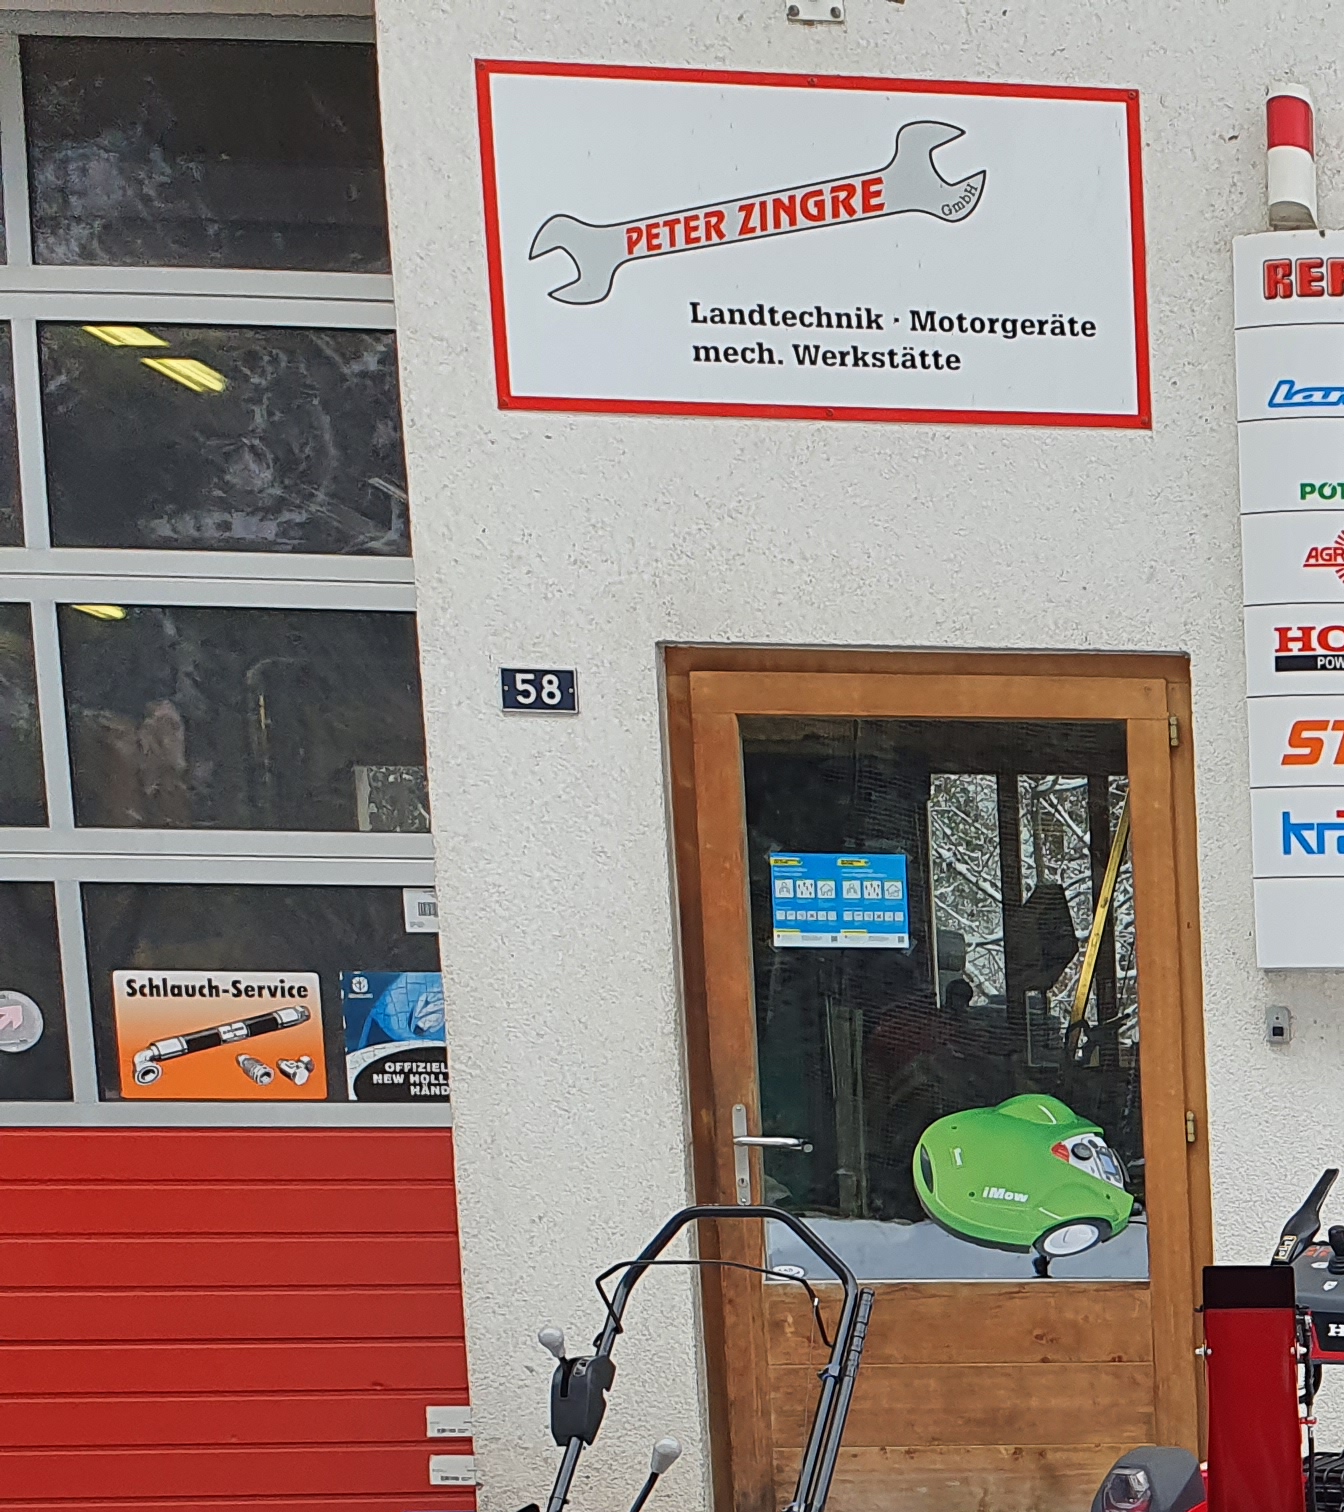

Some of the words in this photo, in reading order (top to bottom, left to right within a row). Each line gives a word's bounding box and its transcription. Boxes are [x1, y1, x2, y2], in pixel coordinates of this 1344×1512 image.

[941, 182, 978, 216] GmbH
[625, 209, 726, 256] PETER
[737, 177, 886, 237] ZINGRE
[690, 302, 884, 332] Landtechnik
[910, 310, 1097, 339] Motorgeräte
[693, 342, 783, 366] mech.
[792, 345, 961, 371] Werkstätte
[515, 673, 562, 705] 58
[125, 977, 309, 999] Schlauch-Service
[372, 1073, 405, 1085] NEW
